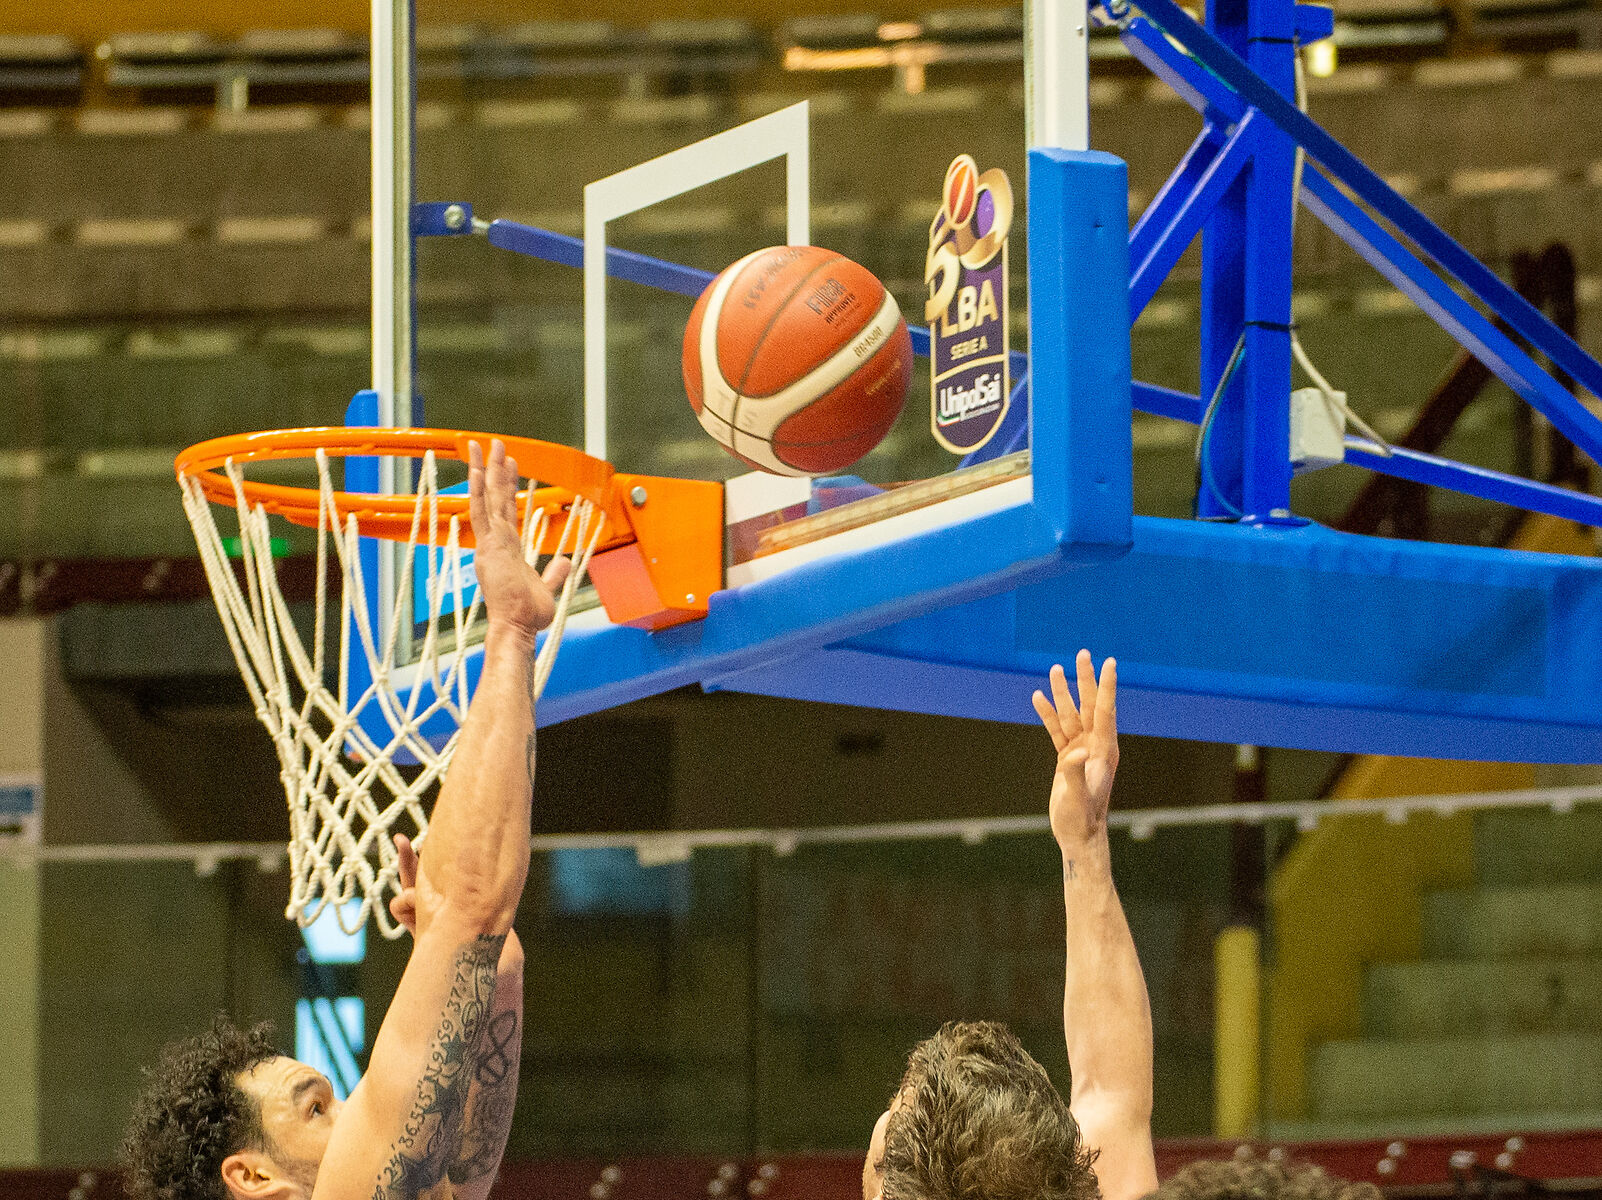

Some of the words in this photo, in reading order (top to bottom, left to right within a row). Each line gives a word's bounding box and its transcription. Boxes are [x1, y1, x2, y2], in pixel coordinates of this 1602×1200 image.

[940, 279, 999, 338] LBA
[950, 337, 979, 361] SERIE
[979, 335, 989, 351] A
[939, 372, 1001, 420] UnipolSai
